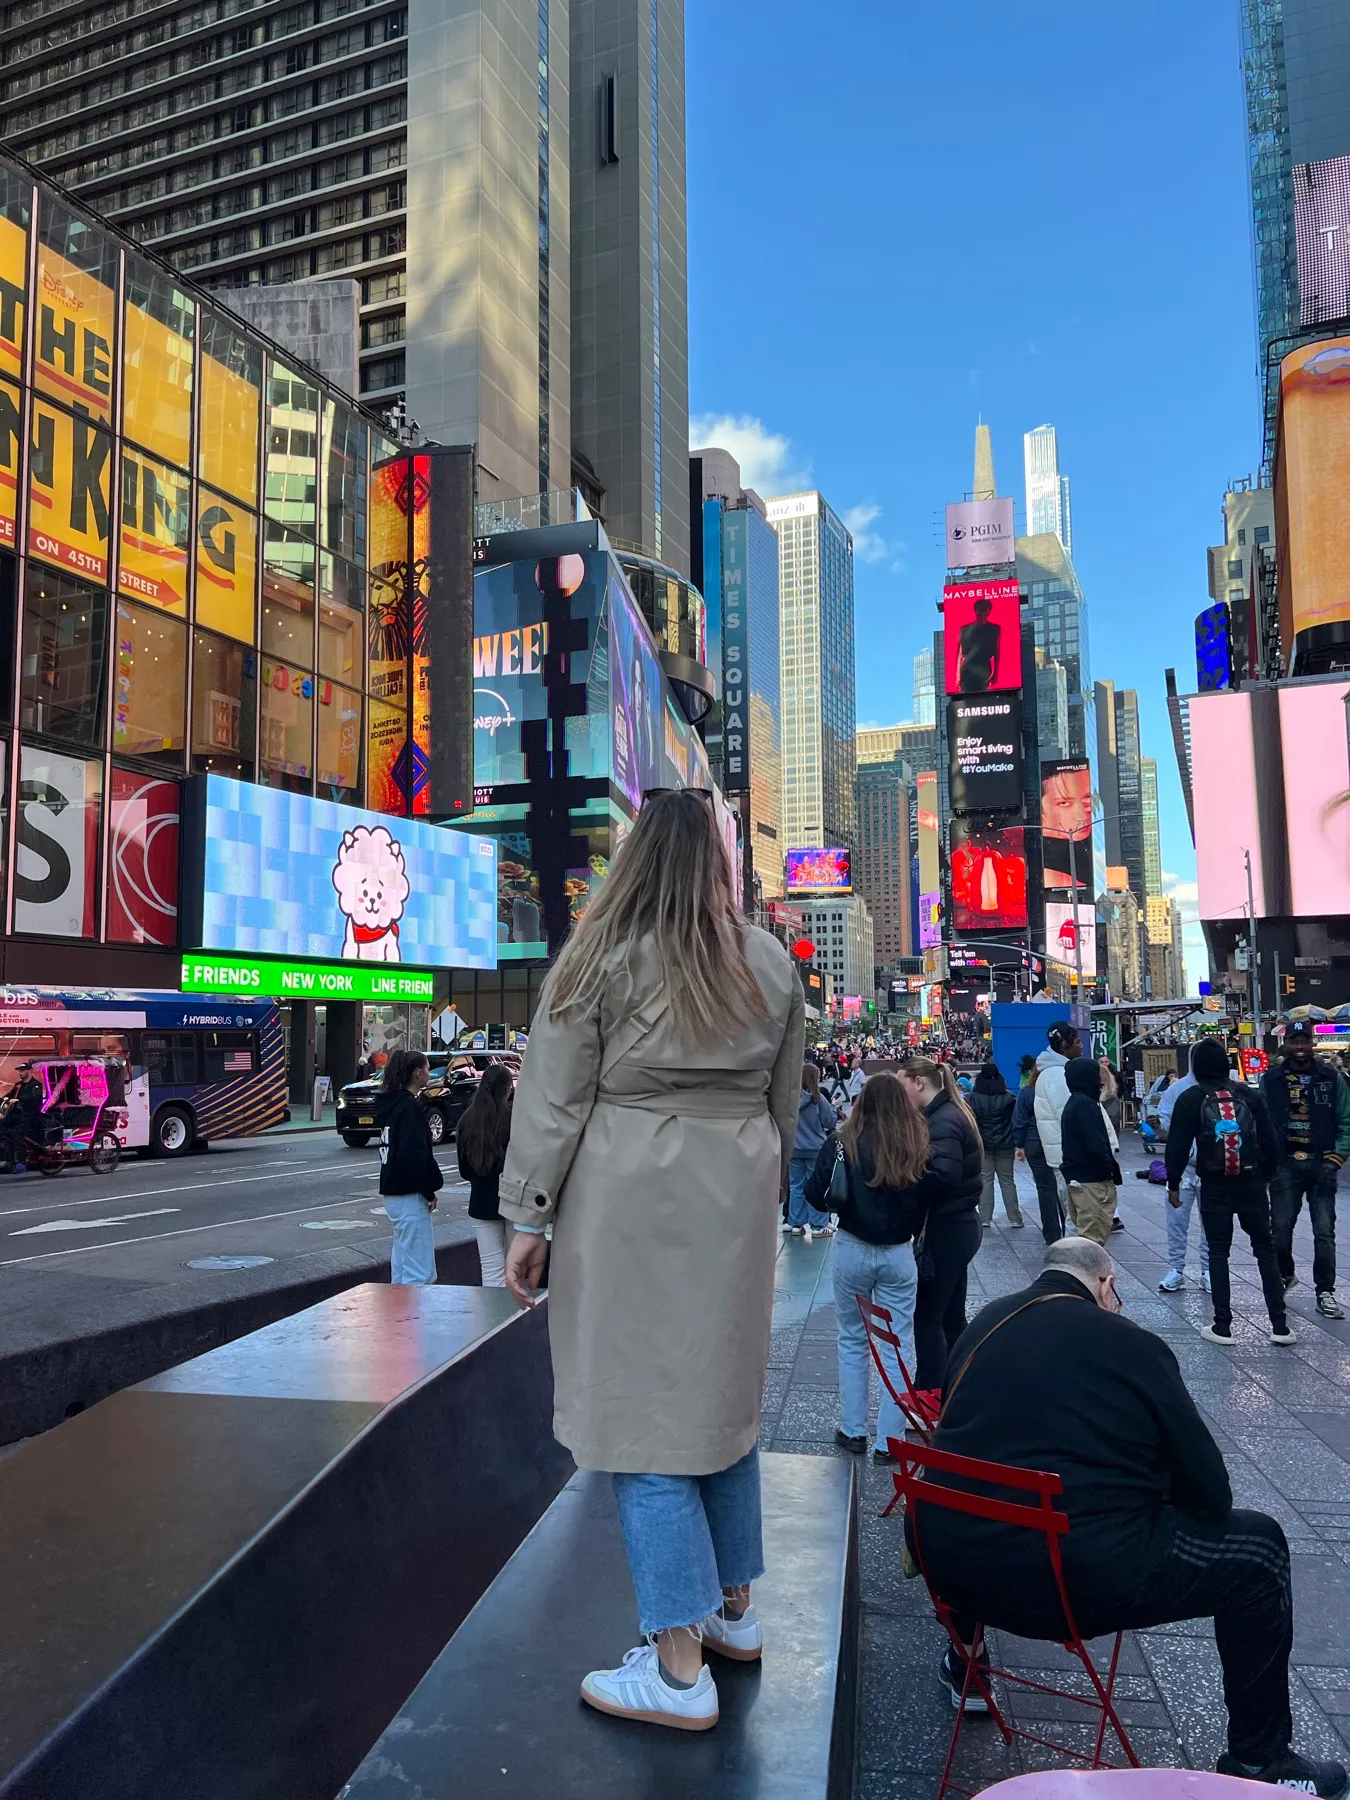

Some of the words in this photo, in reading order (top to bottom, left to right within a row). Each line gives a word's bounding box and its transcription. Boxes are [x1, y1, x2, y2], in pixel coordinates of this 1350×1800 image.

[0, 276, 111, 397] THE
[70, 400, 236, 575] KING
[970, 523, 1002, 536] PGIM
[36, 536, 59, 556] ON
[68, 550, 101, 574] 45TH
[120, 572, 158, 597] STREET
[724, 525, 742, 629] TIMES
[944, 585, 1018, 600] MAYBELLINE
[725, 645, 743, 774] SQUARE
[957, 704, 1011, 718] SAMSUNG
[957, 736, 983, 747] Enjoy
[957, 745, 987, 755] smart
[987, 743, 1013, 755] living
[957, 755, 980, 765] with
[962, 763, 1014, 774] #YouMake
[949, 950, 963, 958] Tell
[949, 959, 966, 967] with
[193, 965, 260, 987] FRIENDS
[281, 971, 315, 989] NEW
[319, 974, 353, 991] YORK
[371, 977, 396, 994] LINE
[4, 989, 39, 1005] bus
[1242, 1047, 1269, 1074] D
